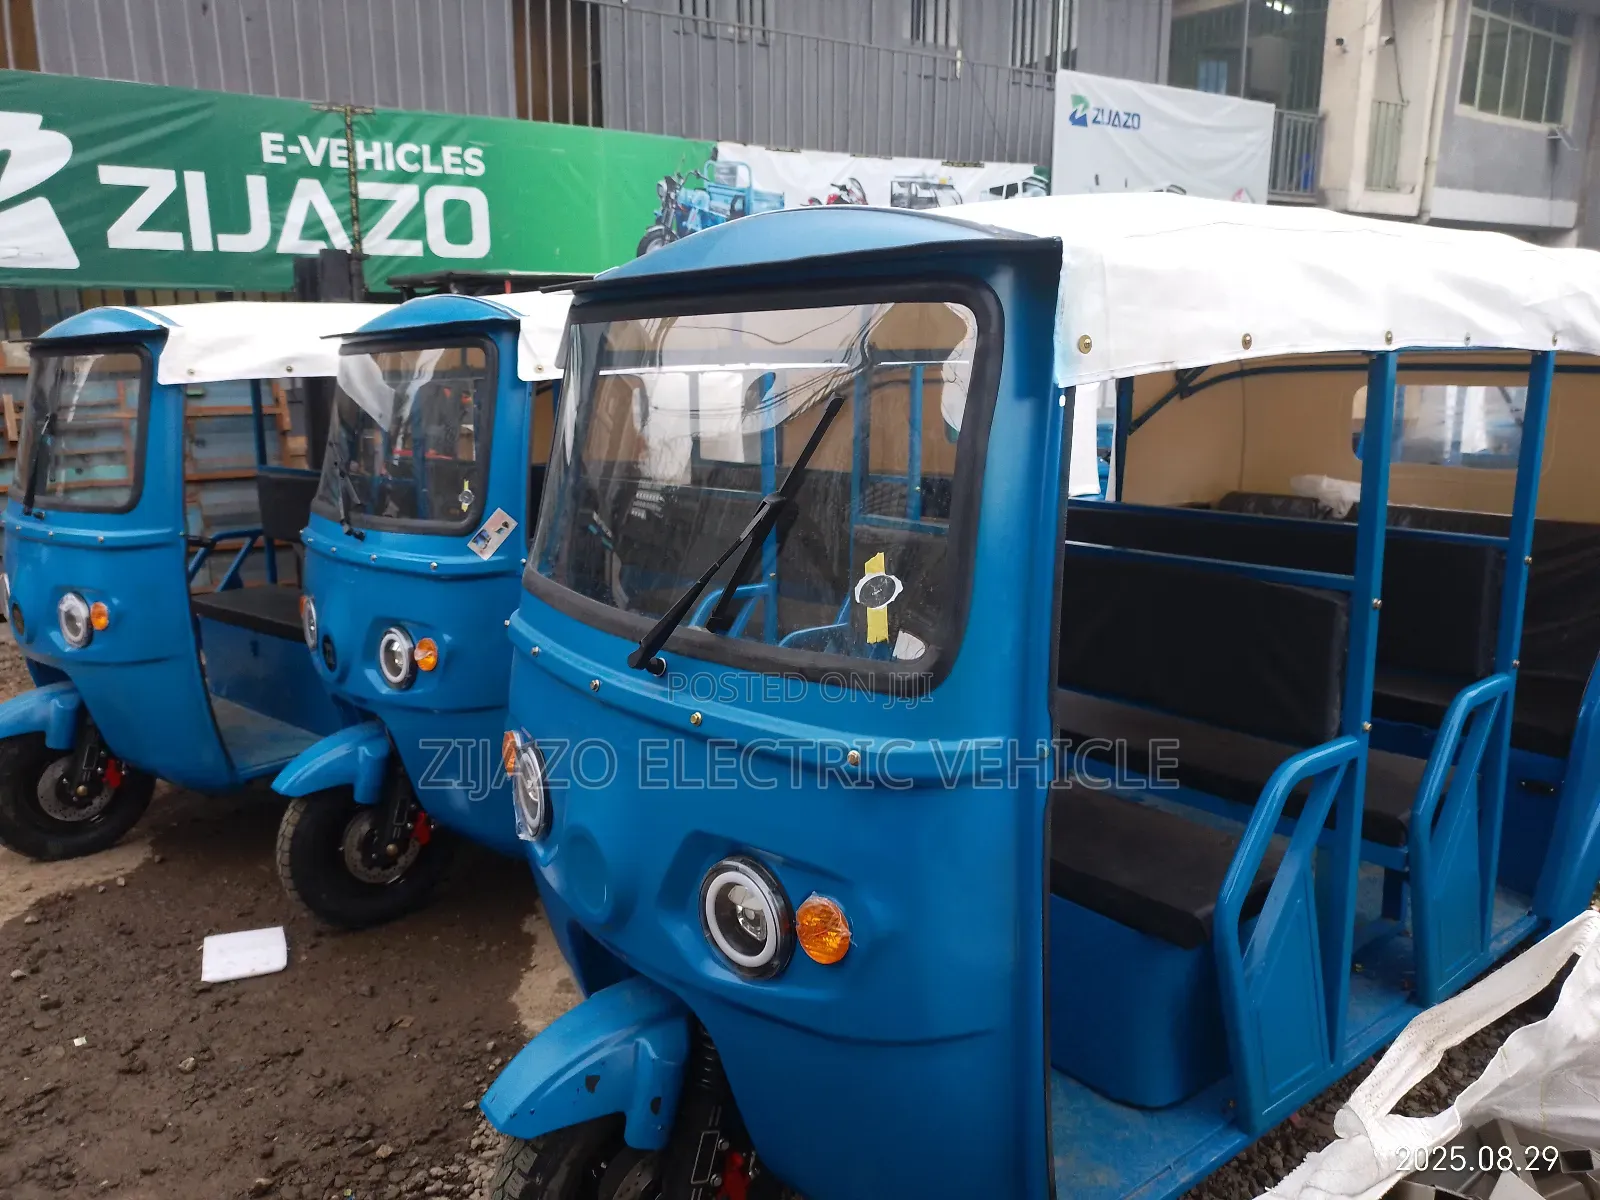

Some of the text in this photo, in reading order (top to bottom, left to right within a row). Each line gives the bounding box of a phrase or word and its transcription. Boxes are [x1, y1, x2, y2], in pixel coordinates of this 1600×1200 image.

[1092, 107, 1141, 130] ZIJAZO
[260, 132, 486, 177] E-VEHICLES
[97, 164, 491, 259] ZIJAZO
